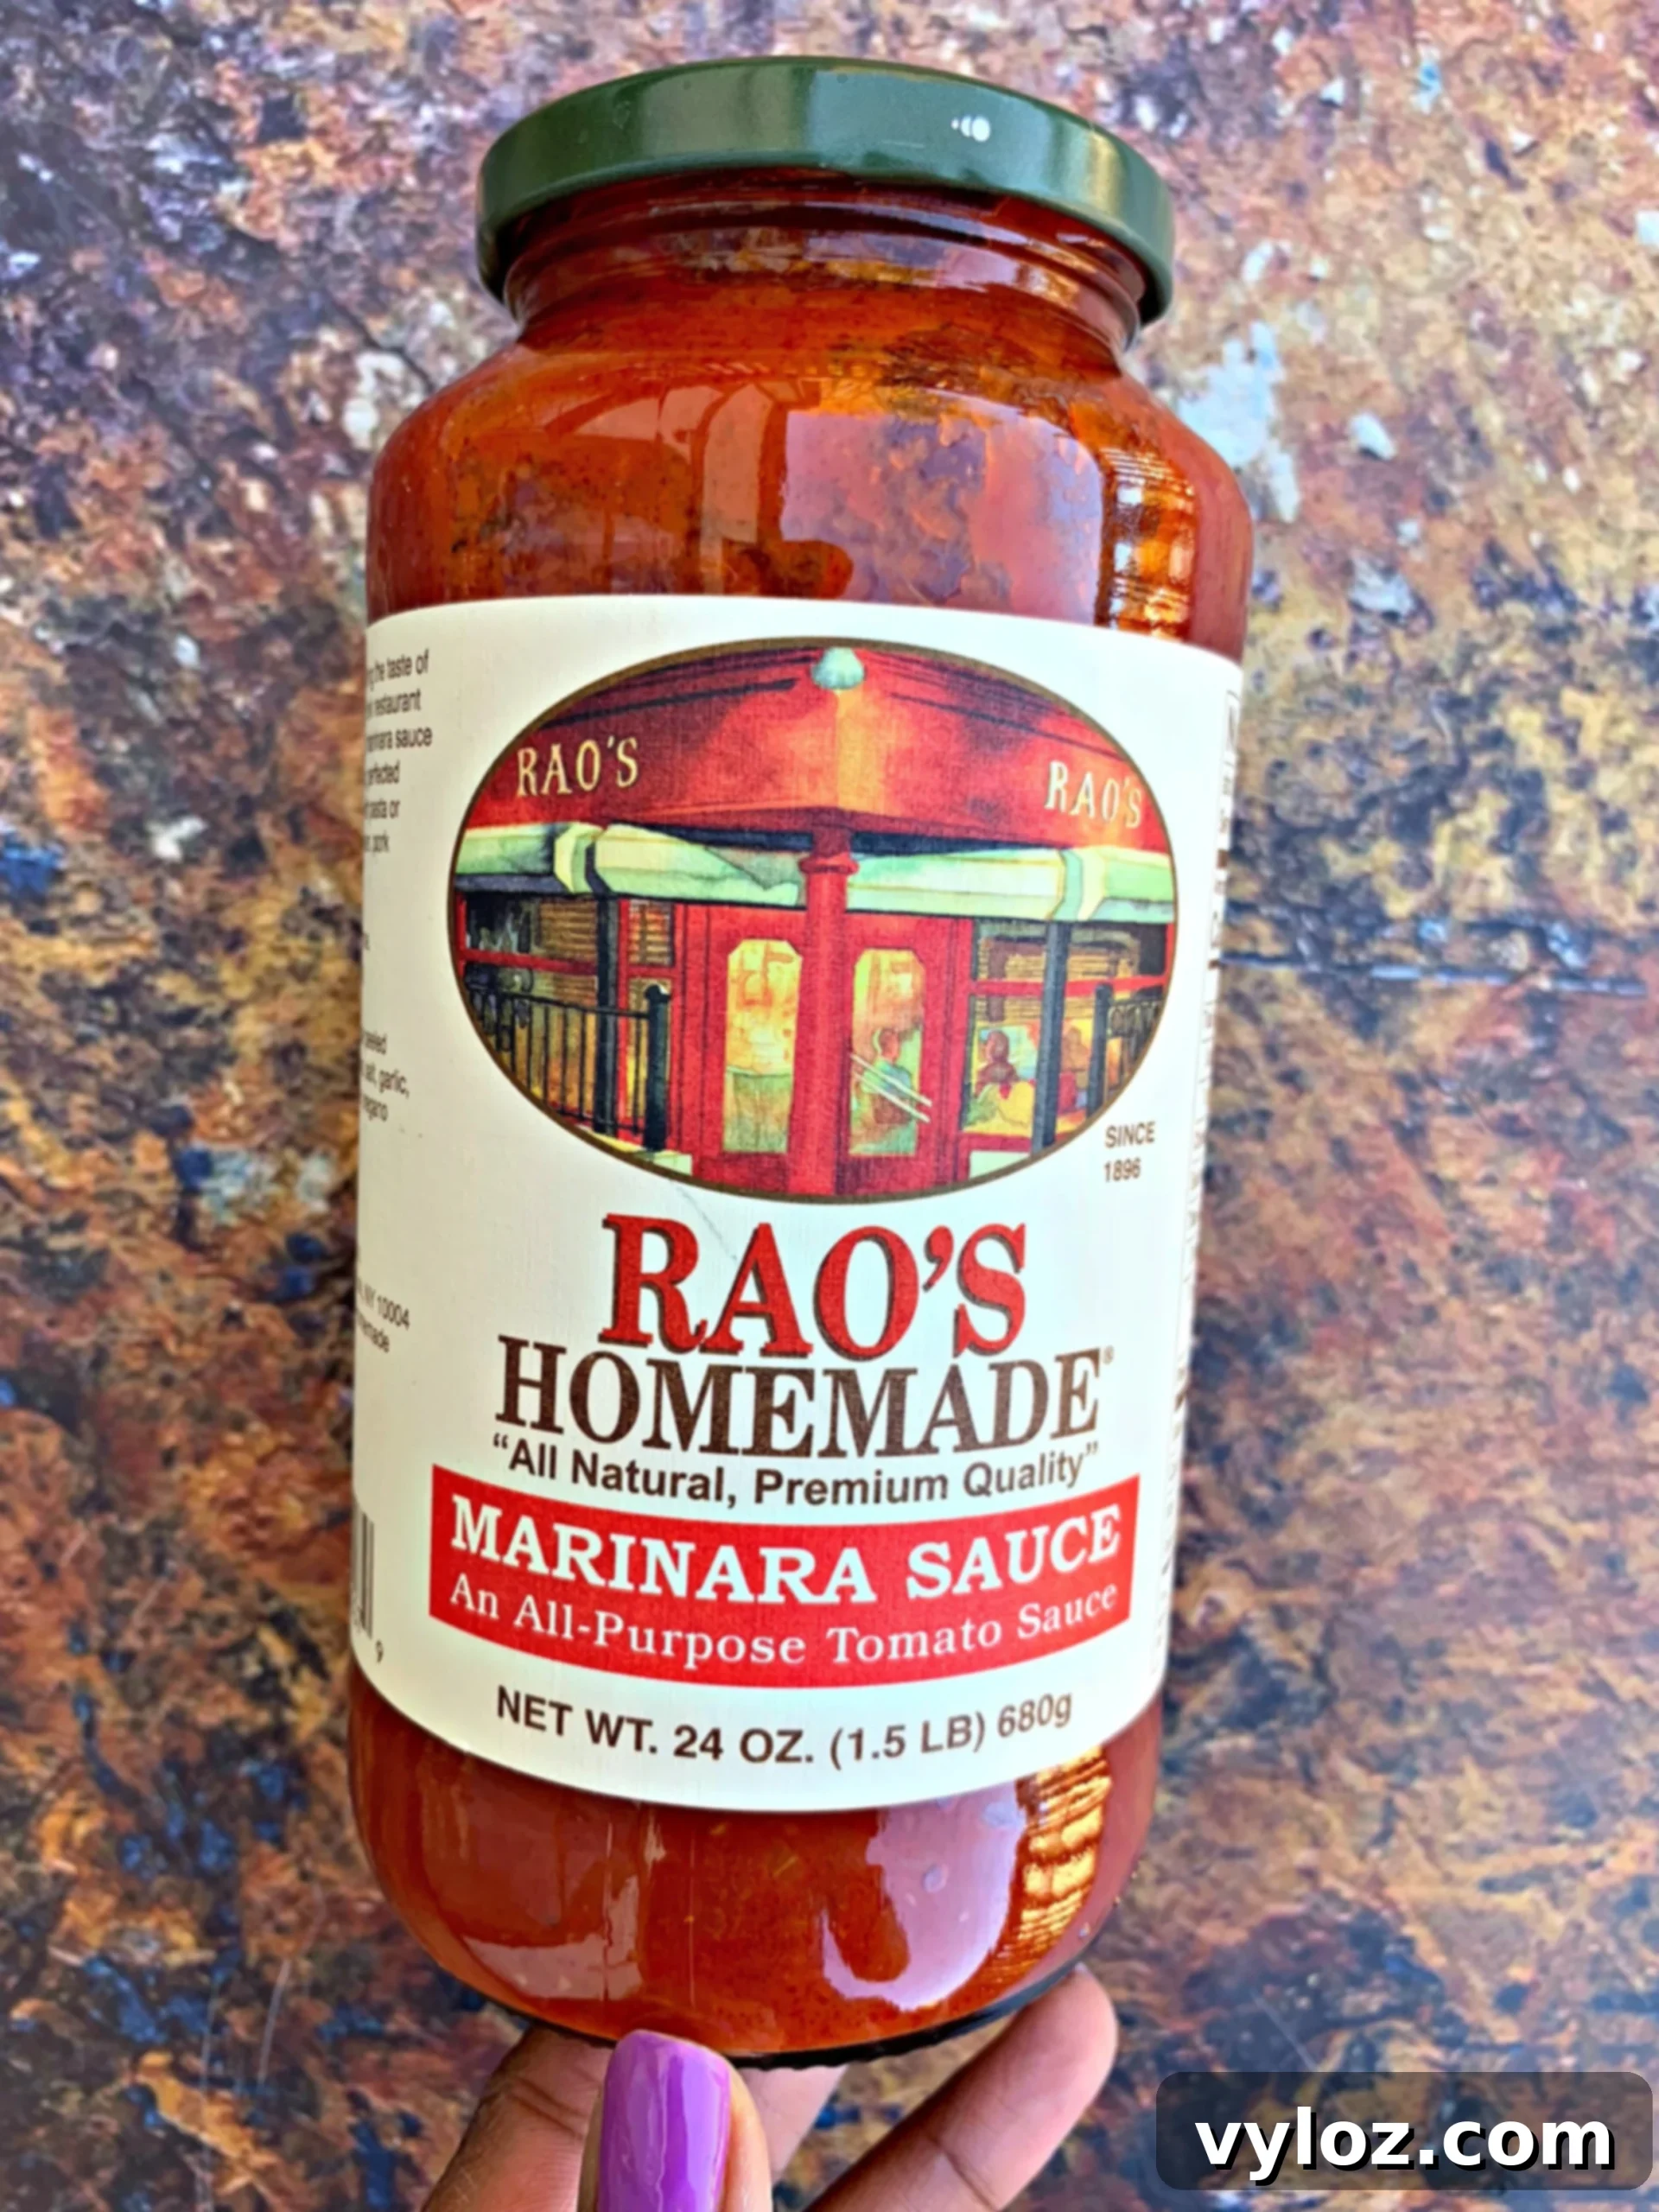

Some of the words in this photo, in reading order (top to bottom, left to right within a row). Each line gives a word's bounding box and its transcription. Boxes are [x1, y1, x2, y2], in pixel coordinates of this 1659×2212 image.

[386, 652, 412, 679] taste
[416, 647, 429, 675] of
[395, 725, 433, 750] sauce
[518, 735, 638, 796] RAO'S
[1044, 760, 1141, 829] RAO'S
[1105, 1121, 1155, 1148] SINCE
[1104, 1157, 1141, 1182] 1896
[377, 1294, 410, 1331] 10004
[598, 1213, 1027, 1363] RAO'S
[572, 1451, 737, 1509] Natural,
[755, 1468, 949, 1506] Premium
[451, 1493, 877, 1605] MARINARA
[906, 1503, 1122, 1600] SAUCE
[449, 1573, 500, 1619] An
[513, 1594, 807, 1670] All-Purpose
[825, 1618, 1001, 1665] Tomato
[1016, 1584, 1118, 1640] Sauce
[496, 1684, 573, 1737] NET
[584, 1707, 658, 1755] WT.
[672, 1723, 724, 1761] 24
[739, 1727, 814, 1764] OZ.
[830, 1723, 906, 1770] (1.5
[920, 1710, 986, 1753] LB)
[997, 1691, 1073, 1738] 680g
